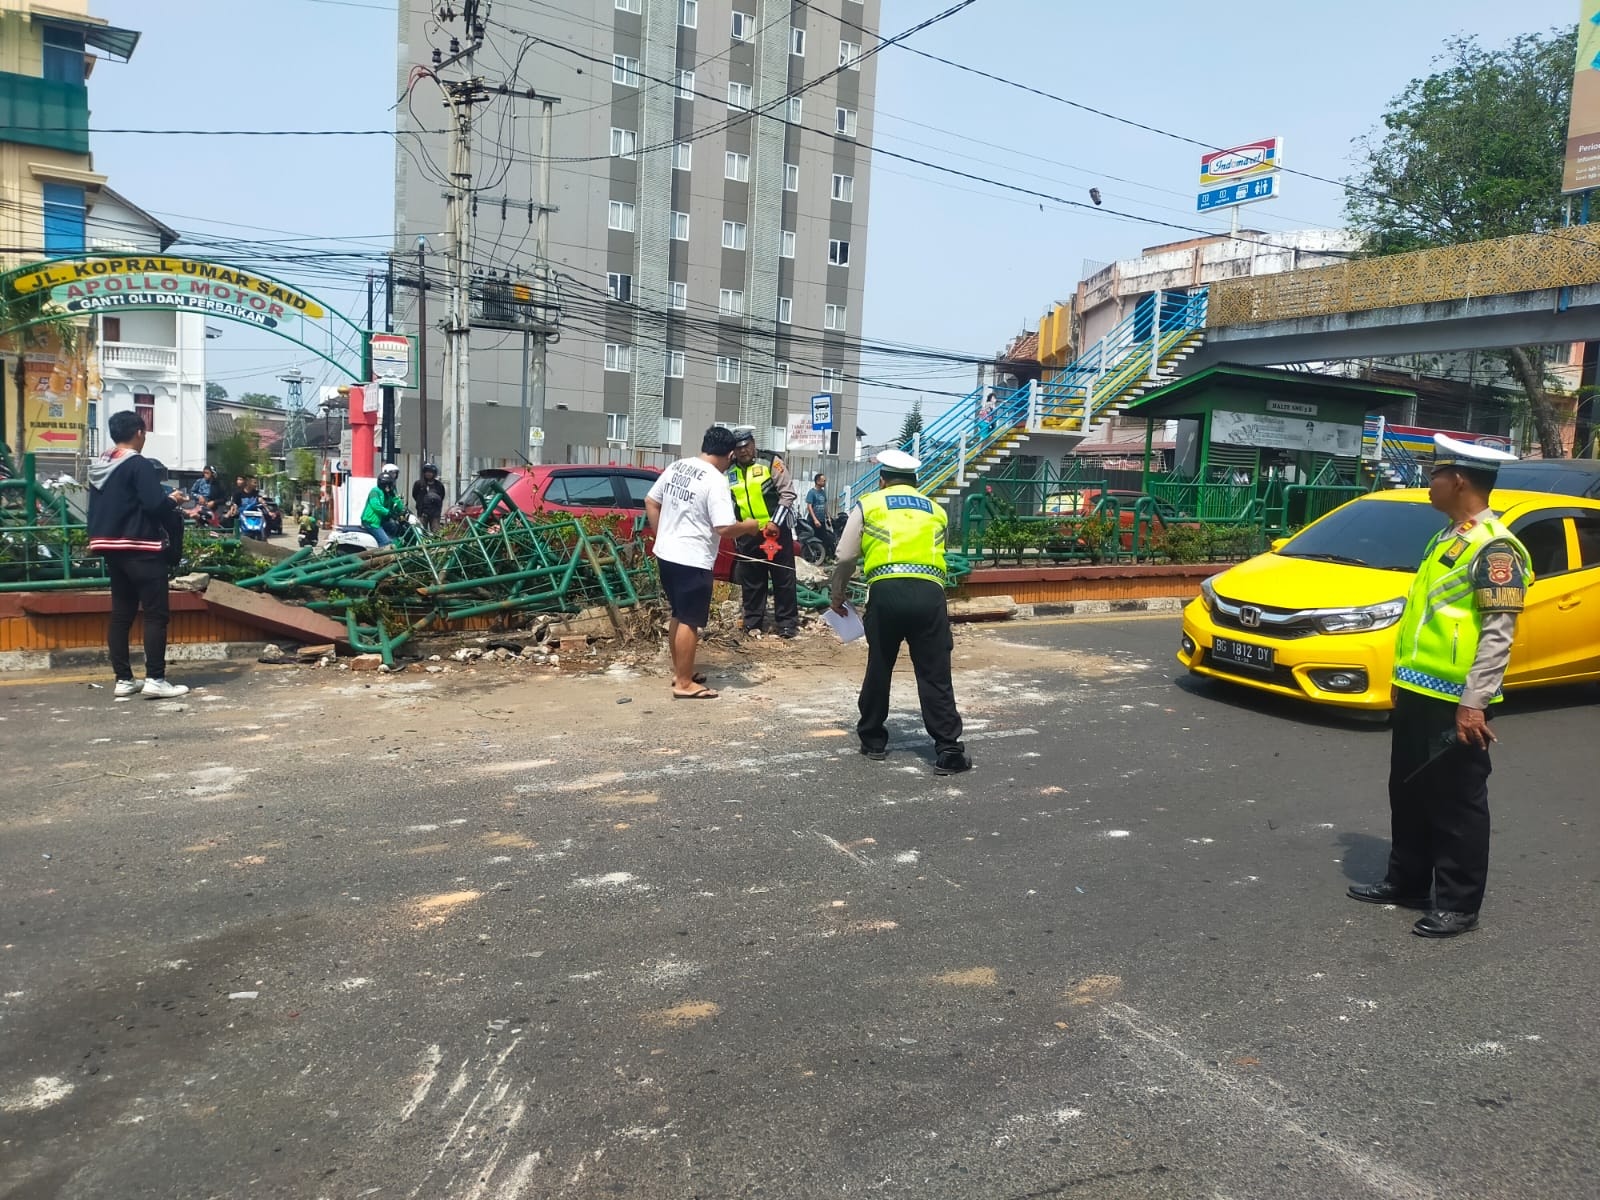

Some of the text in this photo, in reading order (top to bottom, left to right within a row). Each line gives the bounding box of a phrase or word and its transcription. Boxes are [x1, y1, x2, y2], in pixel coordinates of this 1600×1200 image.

[31, 259, 307, 310] JL. KOPRAL UMAR SAID
[67, 277, 285, 318] APOLLO MOTOR
[80, 294, 266, 324] GANTI OLI DAN PERBAIKAN
[815, 412, 829, 422] STOP
[671, 472, 691, 488] GOOD
[684, 465, 708, 481] BIKE
[887, 496, 932, 513] POLISI
[1216, 638, 1227, 652] BG
[1232, 642, 1253, 658] 1812
[1257, 647, 1269, 661] DY
